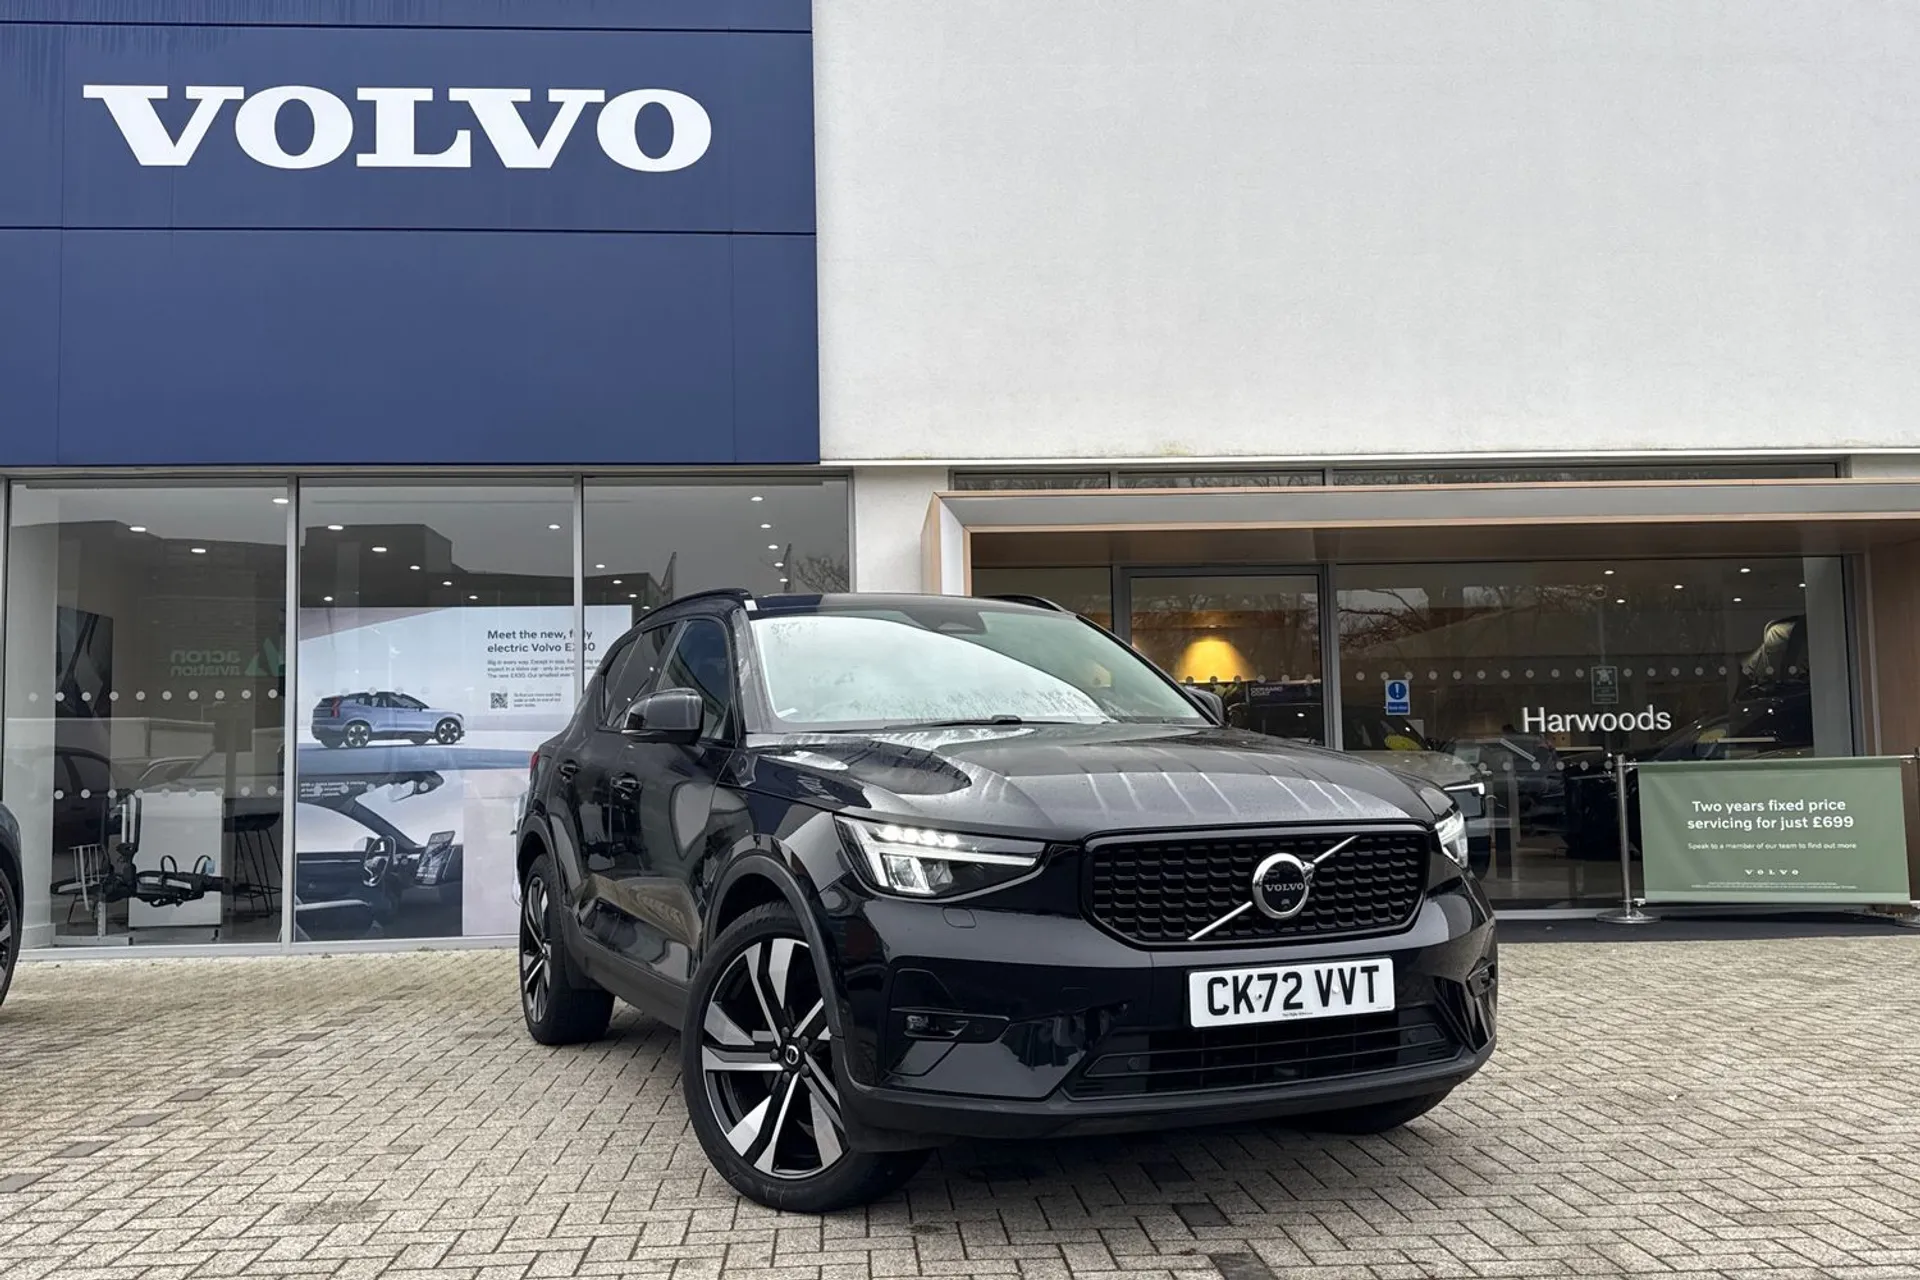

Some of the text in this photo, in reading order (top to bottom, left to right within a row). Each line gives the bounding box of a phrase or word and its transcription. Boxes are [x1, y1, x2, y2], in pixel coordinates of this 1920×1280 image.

[83, 85, 712, 172] VOLVO
[487, 630, 516, 639] Meet
[519, 630, 537, 639] the
[540, 631, 566, 640] new,
[487, 642, 596, 653] electric Volvo E30
[1522, 704, 1672, 733] Harwoods
[1692, 799, 1846, 814] Two years fixed price
[1687, 815, 1854, 831] servicing for just £699
[1725, 842, 1755, 850] member
[1756, 842, 1764, 850] of
[1264, 882, 1304, 892] VOLVO
[1207, 965, 1380, 1016] CK72 VVT
